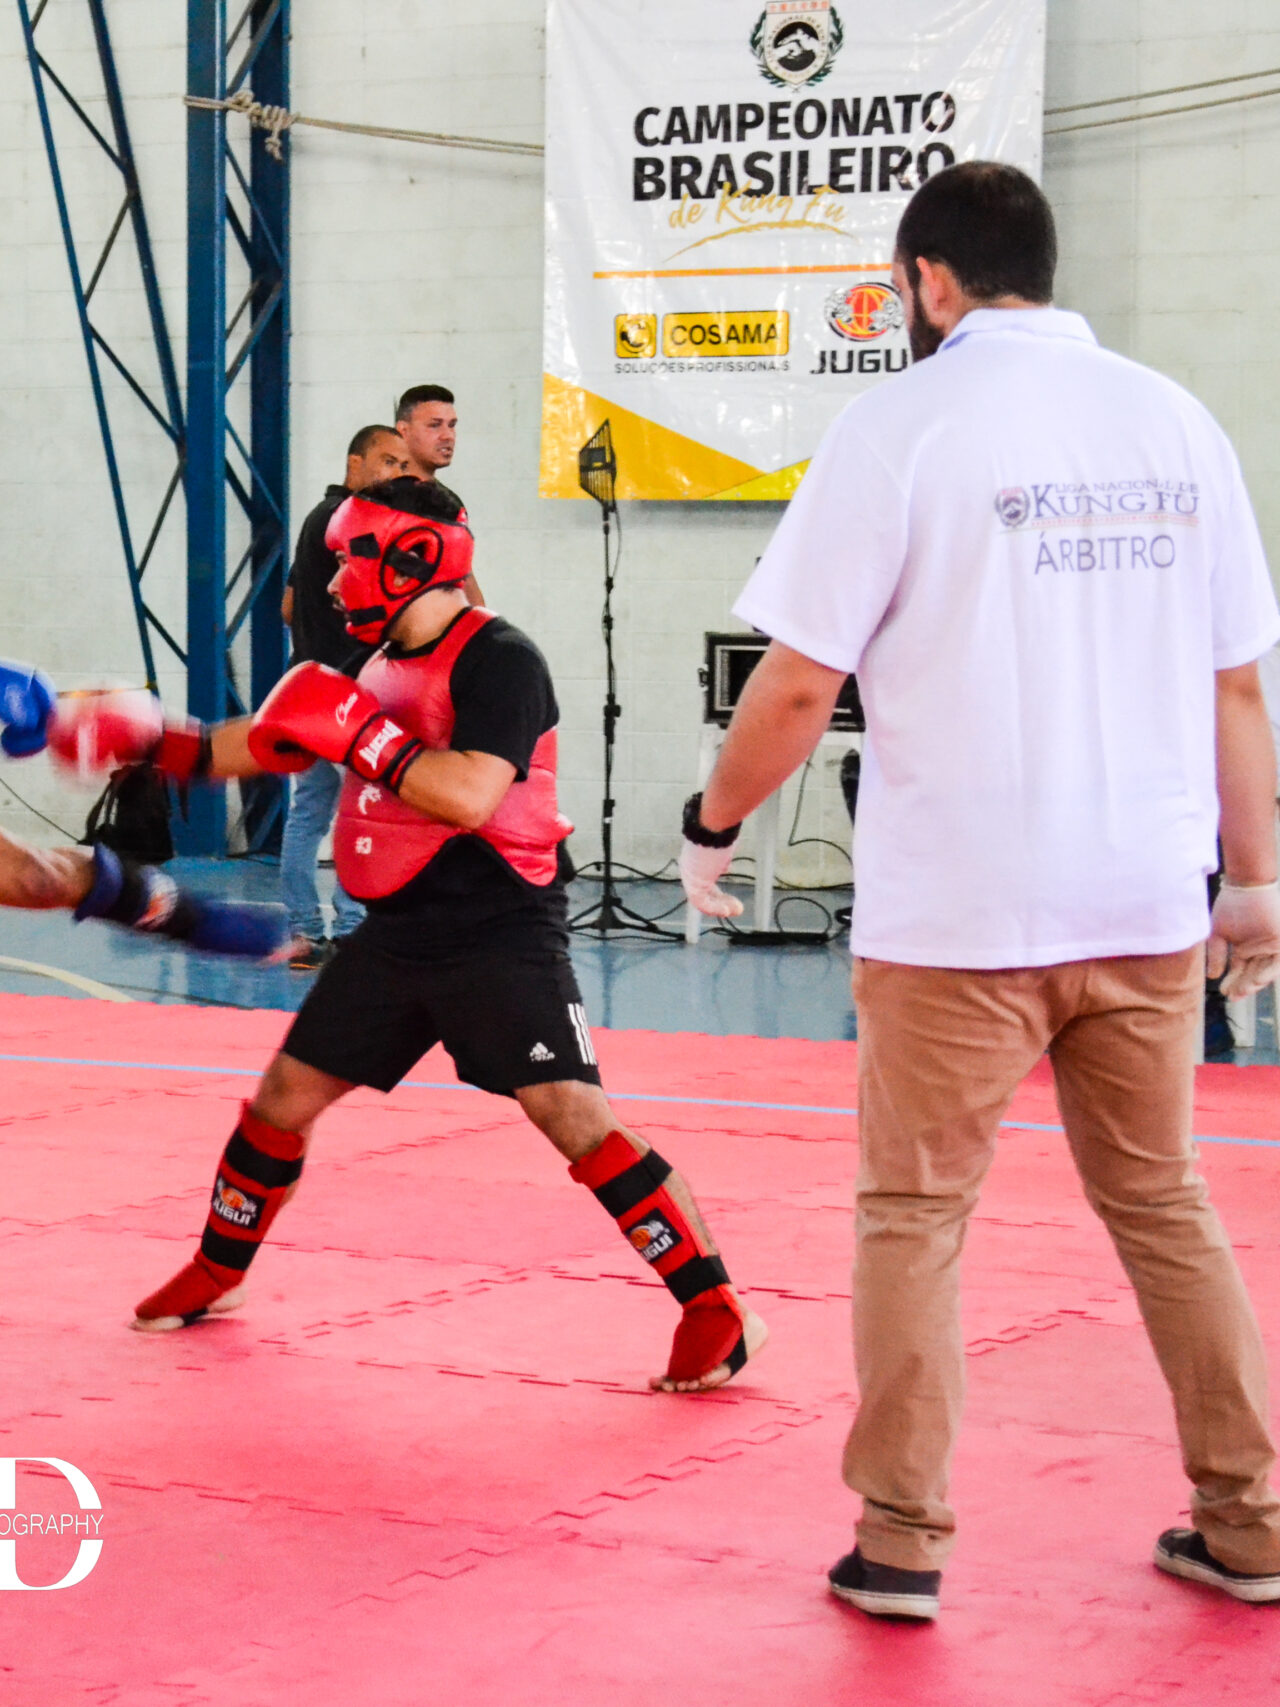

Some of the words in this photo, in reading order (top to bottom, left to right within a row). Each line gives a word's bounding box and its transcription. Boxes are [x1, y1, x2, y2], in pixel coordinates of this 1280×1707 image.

[633, 91, 956, 147] CAMPEONATO
[633, 142, 956, 202] BRASILEIRO
[669, 193, 704, 230] de
[716, 180, 794, 224] Kung
[803, 183, 848, 223] Fu
[670, 323, 779, 346] COSAMA
[687, 360, 790, 373] PROFISSIONAS
[810, 348, 909, 374] JUGU
[1031, 484, 1147, 518] KUNG
[1155, 491, 1200, 515] FU
[1035, 531, 1176, 575] ÁRBITRO
